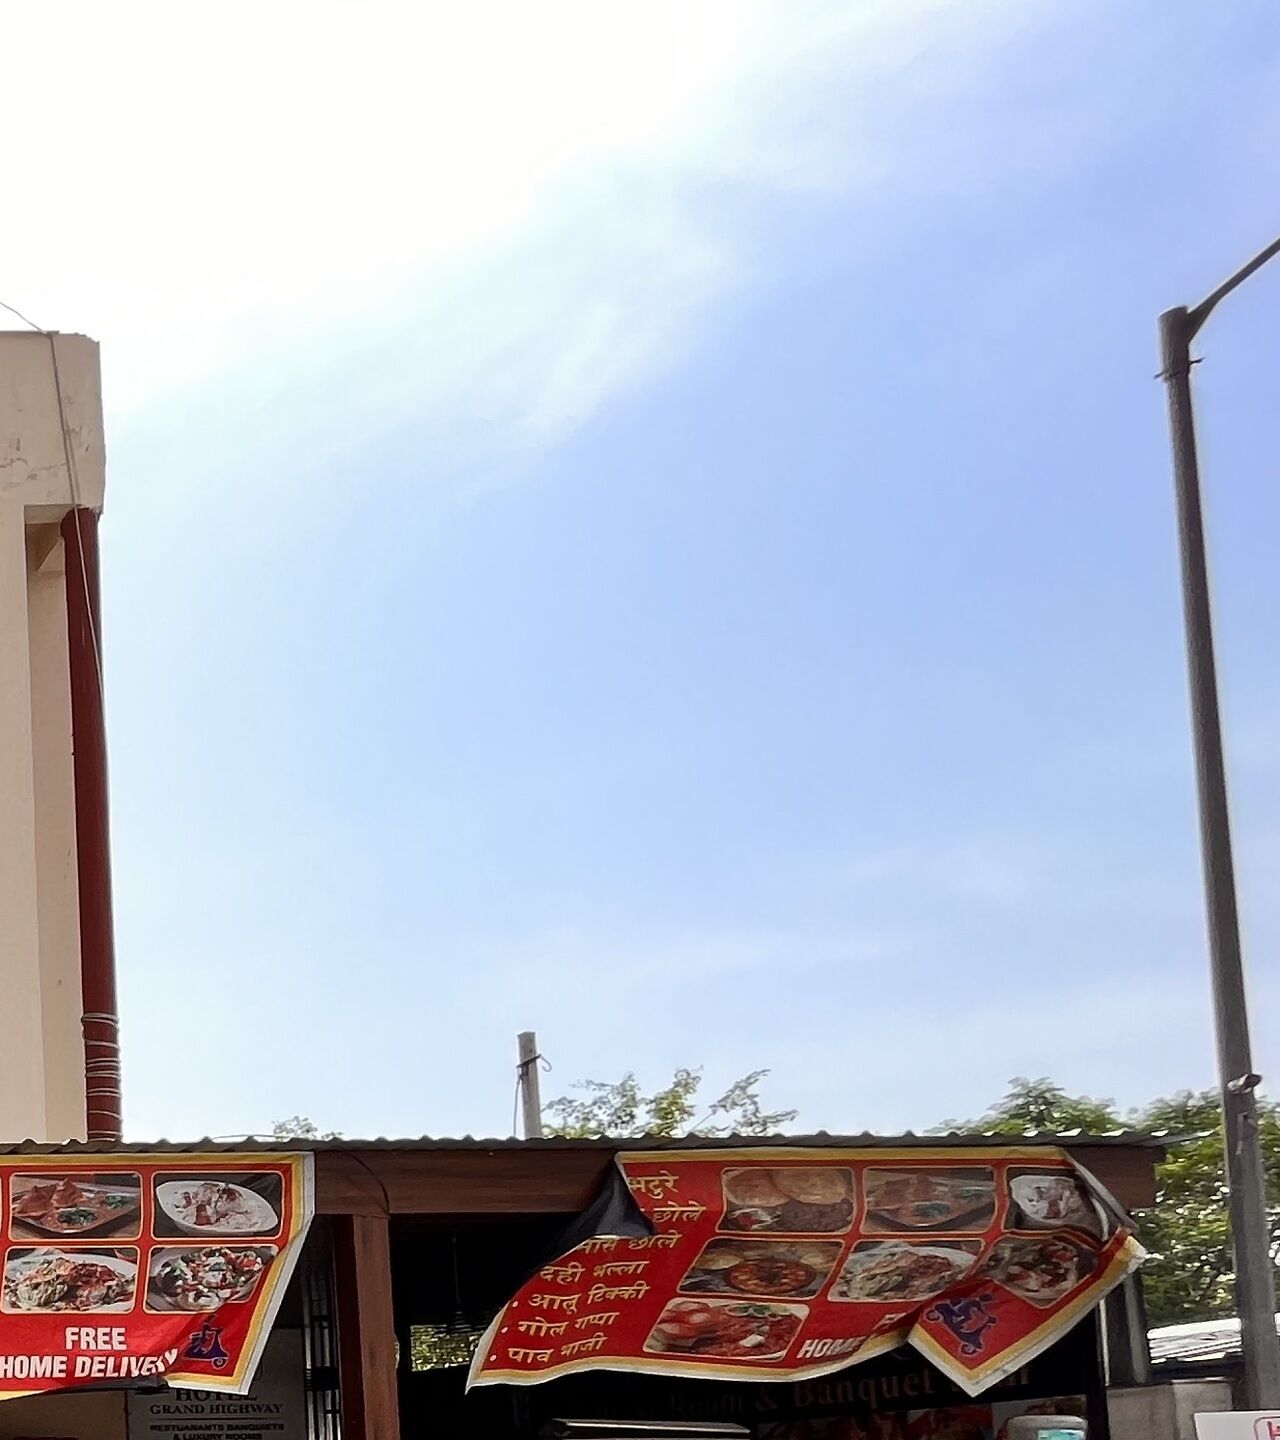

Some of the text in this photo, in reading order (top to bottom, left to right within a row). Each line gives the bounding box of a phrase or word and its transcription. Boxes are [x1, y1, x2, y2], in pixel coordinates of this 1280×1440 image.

[64, 1327, 128, 1351] FREE
[149, 1402, 284, 1415] GRAND HIGHWAY
